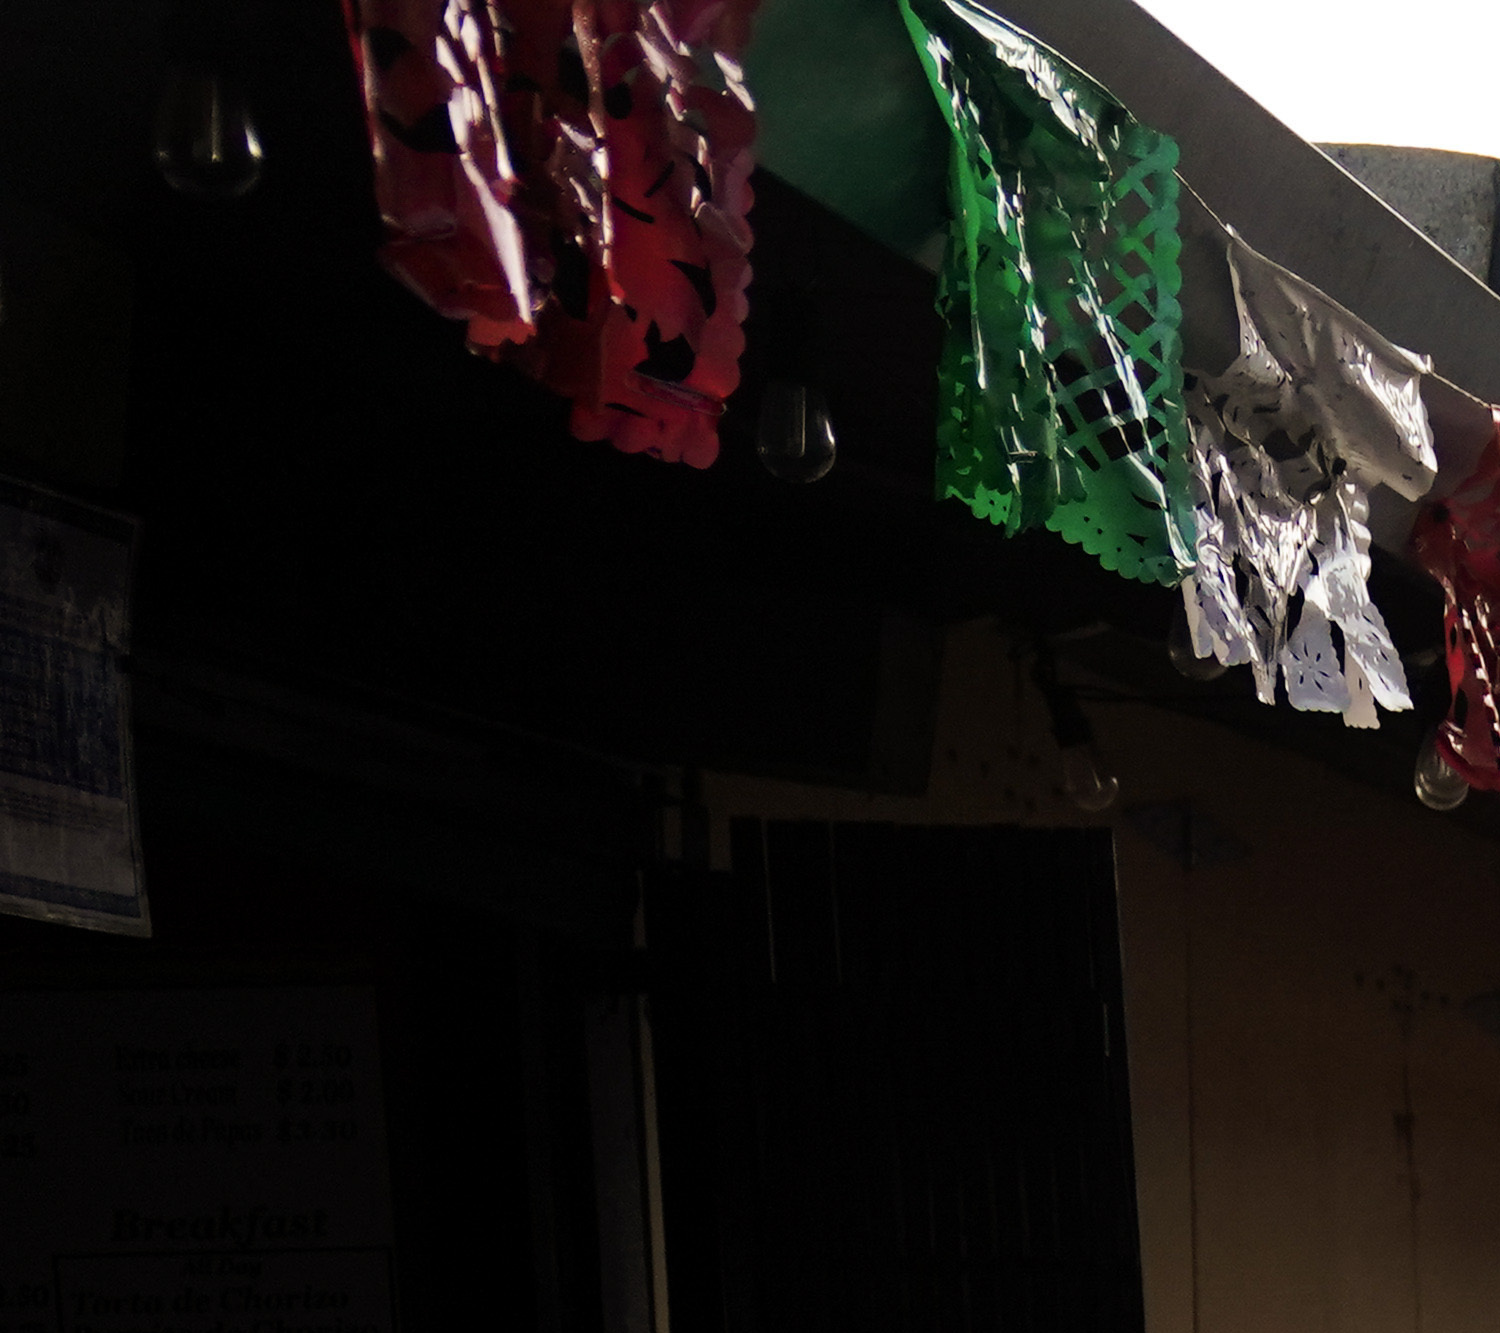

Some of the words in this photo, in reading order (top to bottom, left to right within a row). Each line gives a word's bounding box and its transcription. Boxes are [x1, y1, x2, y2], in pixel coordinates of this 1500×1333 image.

[111, 1205, 329, 1248] Breakfast
[72, 1291, 163, 1316] Torta
[172, 1288, 210, 1314] de
[220, 1284, 350, 1312] Chorizo
